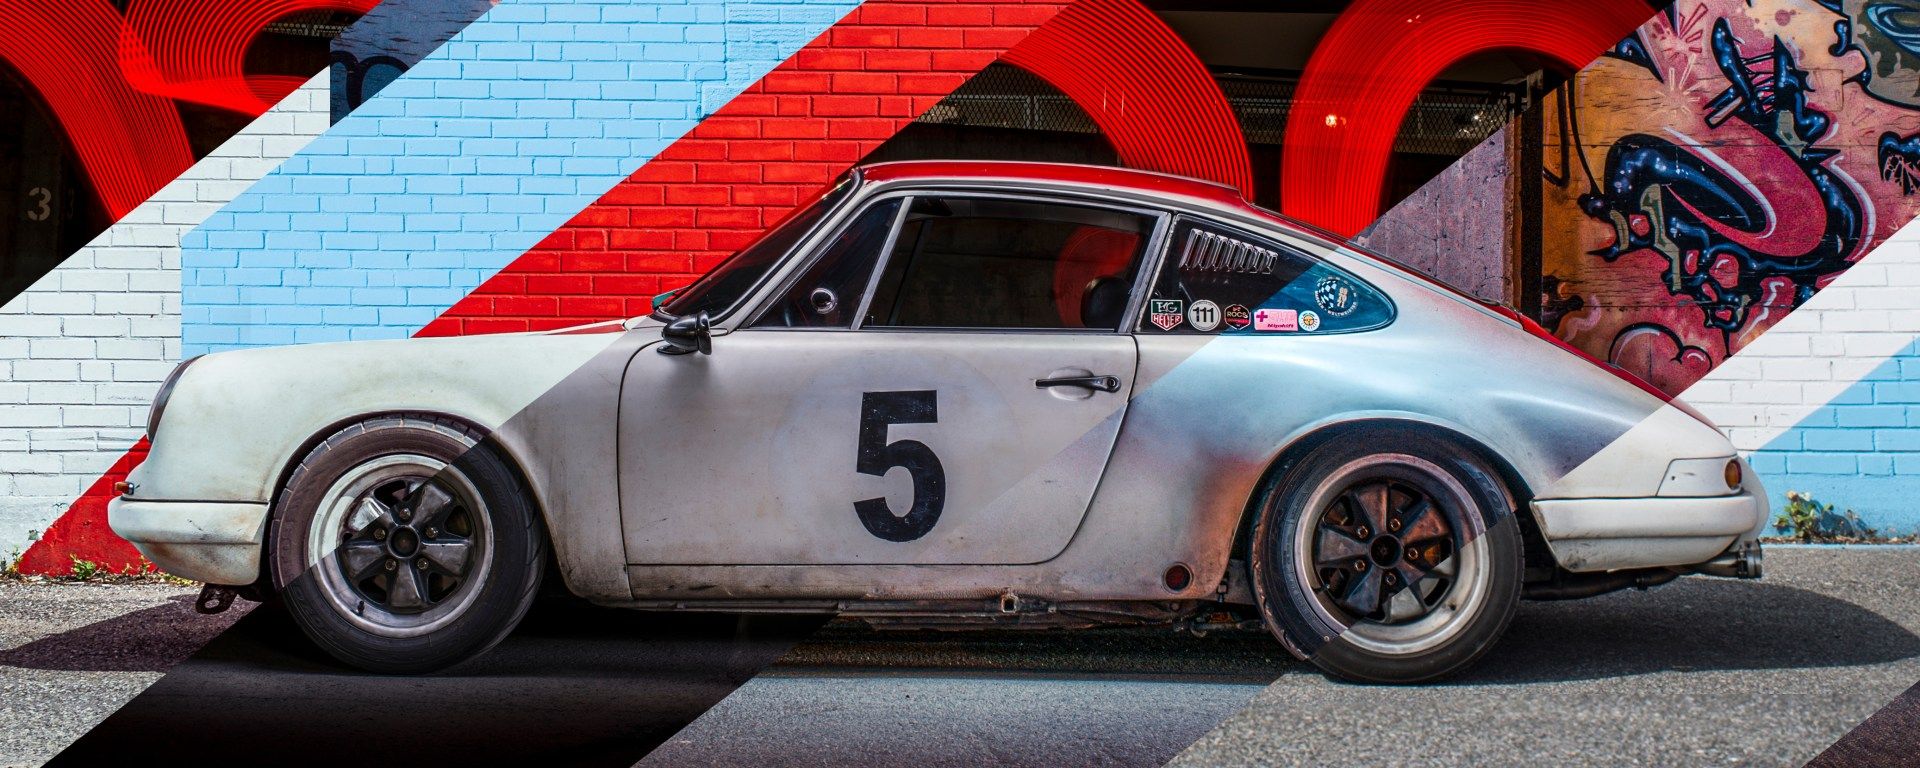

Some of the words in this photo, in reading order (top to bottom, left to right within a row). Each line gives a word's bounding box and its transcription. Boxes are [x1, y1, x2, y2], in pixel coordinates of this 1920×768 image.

[28, 187, 52, 222] 3
[1153, 314, 1181, 329] HEUER
[1193, 306, 1214, 323] 111
[853, 389, 946, 542] 5
